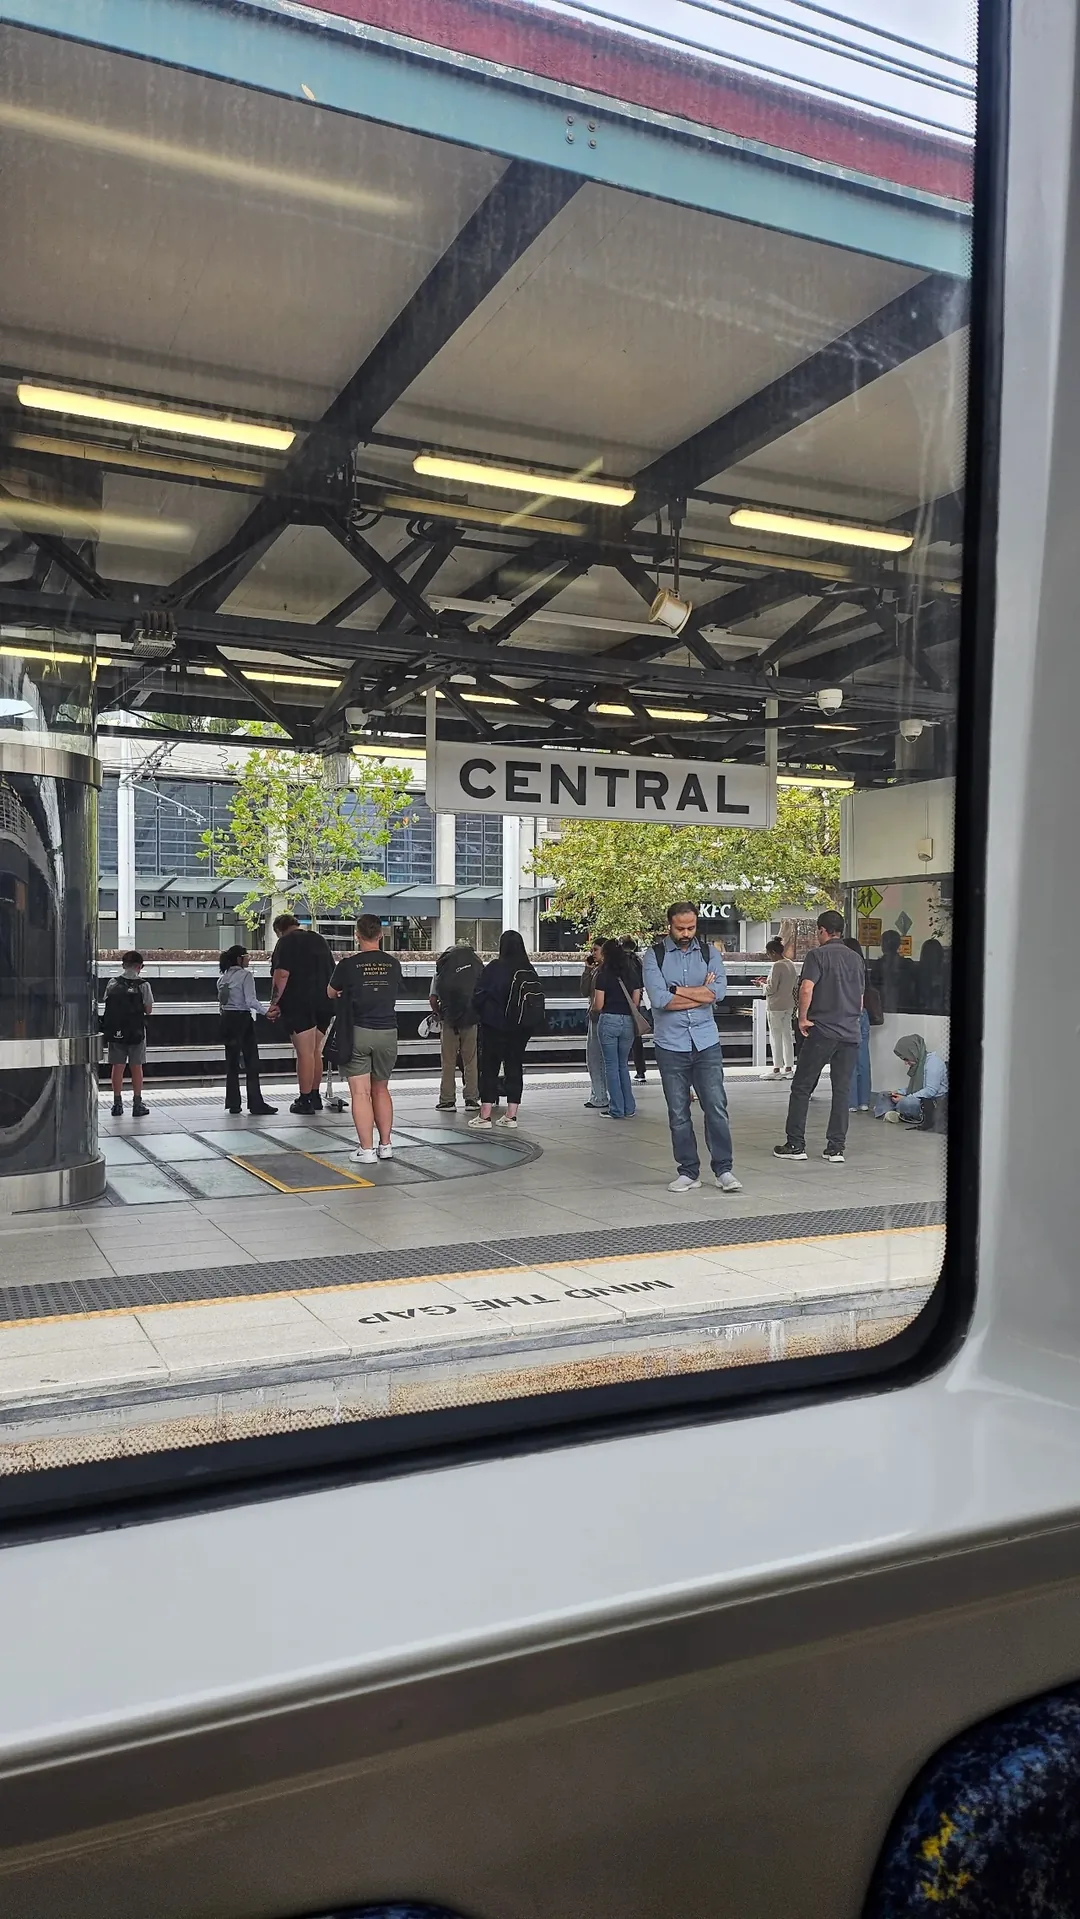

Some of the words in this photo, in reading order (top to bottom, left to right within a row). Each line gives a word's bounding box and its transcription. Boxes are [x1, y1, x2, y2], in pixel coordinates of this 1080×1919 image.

[459, 758, 750, 815] CENTRAL
[140, 895, 235, 909] CENTRAL
[698, 903, 731, 918] KFC
[563, 1279, 676, 1300] MIND
[466, 1293, 561, 1312] THE
[357, 1304, 458, 1326] GAP
